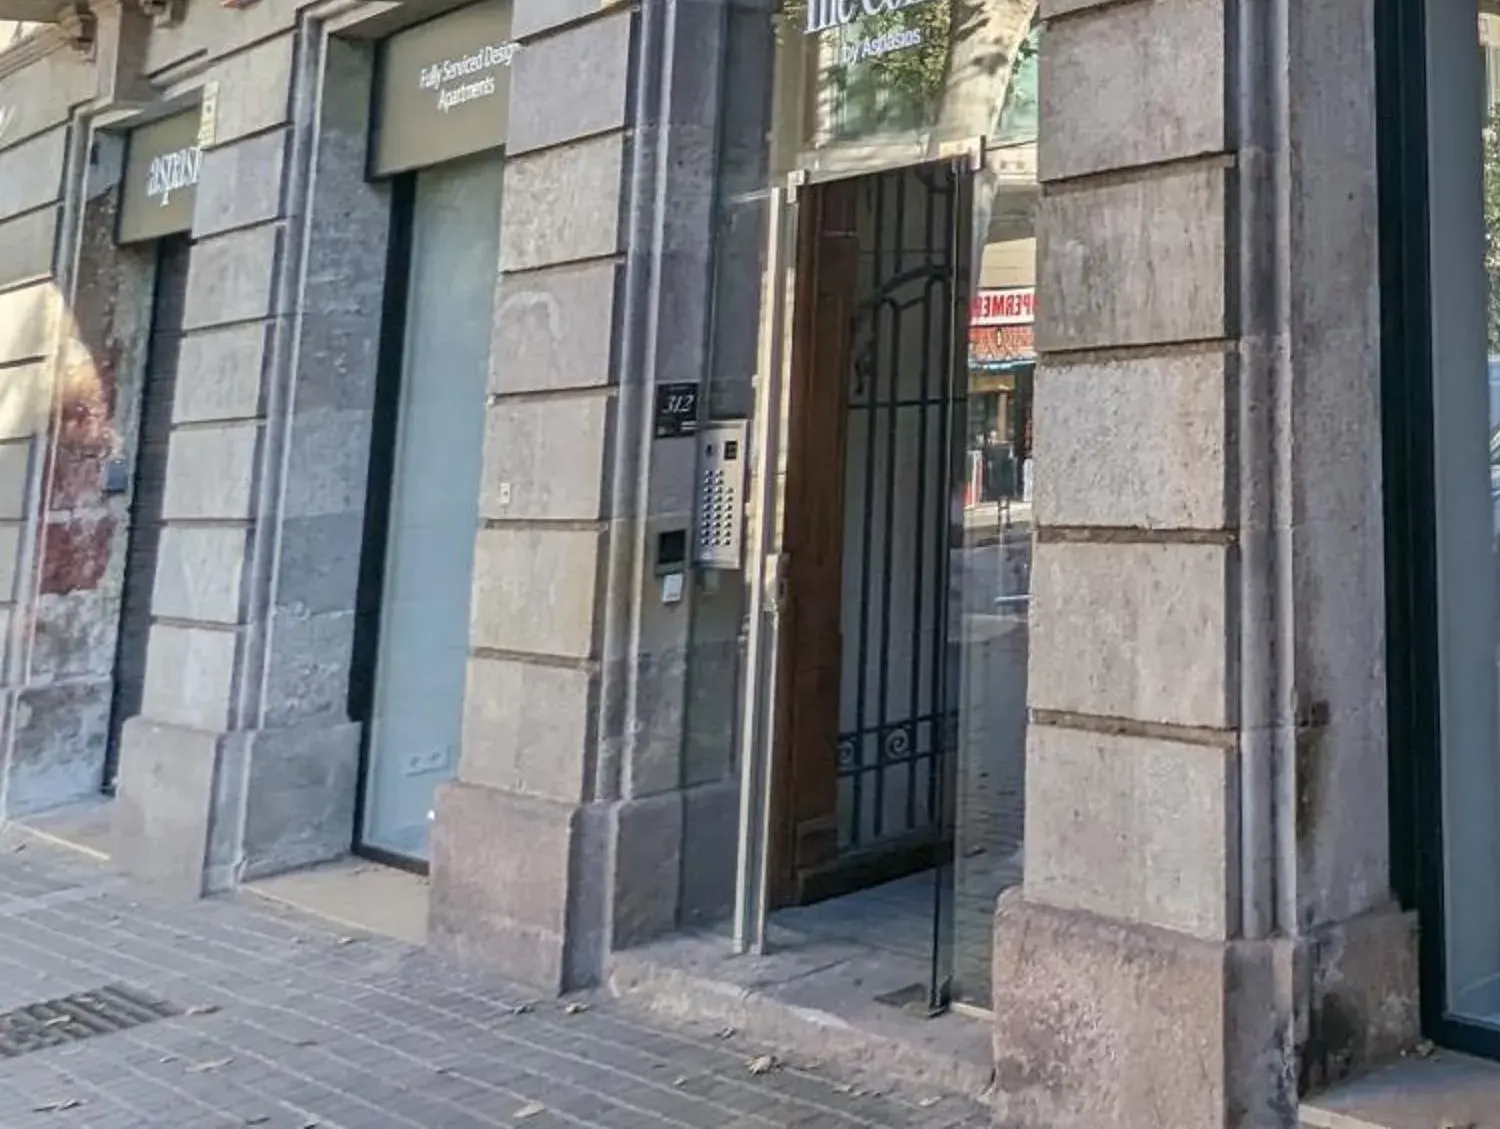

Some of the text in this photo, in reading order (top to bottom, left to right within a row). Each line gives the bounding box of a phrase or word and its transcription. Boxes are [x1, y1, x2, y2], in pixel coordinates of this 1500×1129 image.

[841, 27, 921, 66] by Aspasios
[420, 64, 441, 91] Fully
[442, 49, 484, 82] Serviced
[437, 75, 496, 114] Apartments
[661, 393, 695, 415] 312
